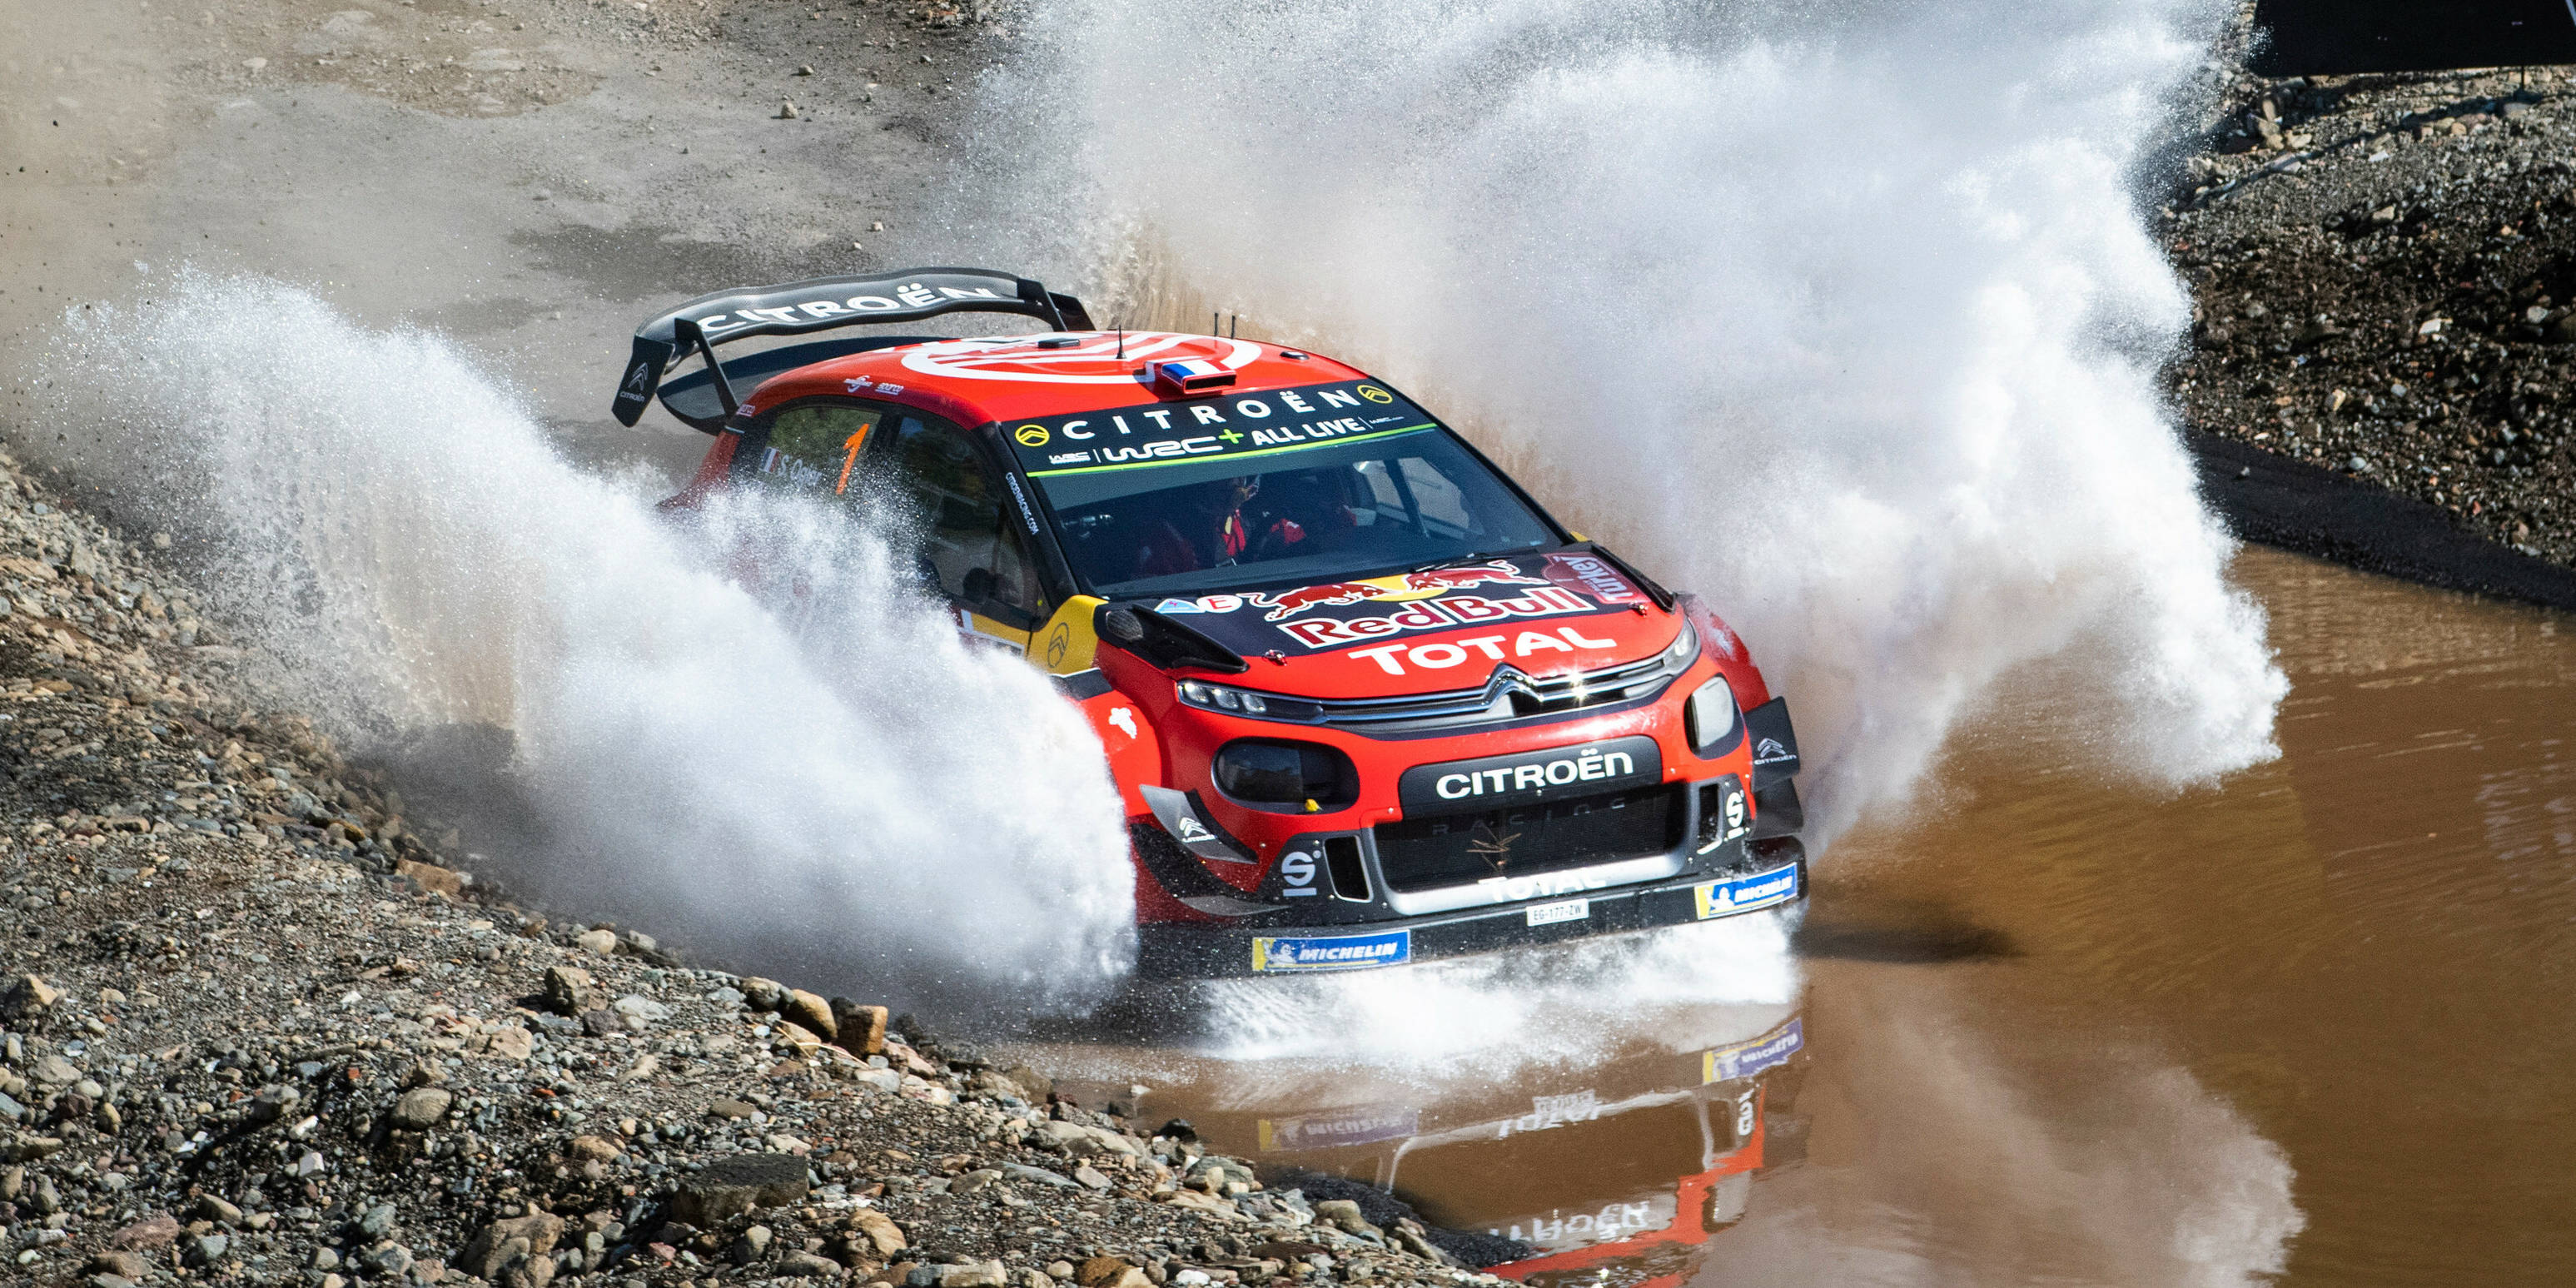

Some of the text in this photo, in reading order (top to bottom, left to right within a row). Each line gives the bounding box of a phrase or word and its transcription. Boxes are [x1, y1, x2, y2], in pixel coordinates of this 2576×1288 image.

[696, 283, 999, 332] CITROËN
[1062, 390, 1361, 440] CITROËN
[1251, 425, 1306, 445] ALL
[1302, 417, 1366, 438] LIVE
[835, 423, 869, 495] 1
[1348, 627, 1617, 675] TOTAL
[1436, 748, 1634, 799] CITROËN
[1477, 868, 1607, 903] TOTAL
[1734, 875, 1793, 903] MICHELIN
[1299, 942, 1398, 961] MICHELIN
